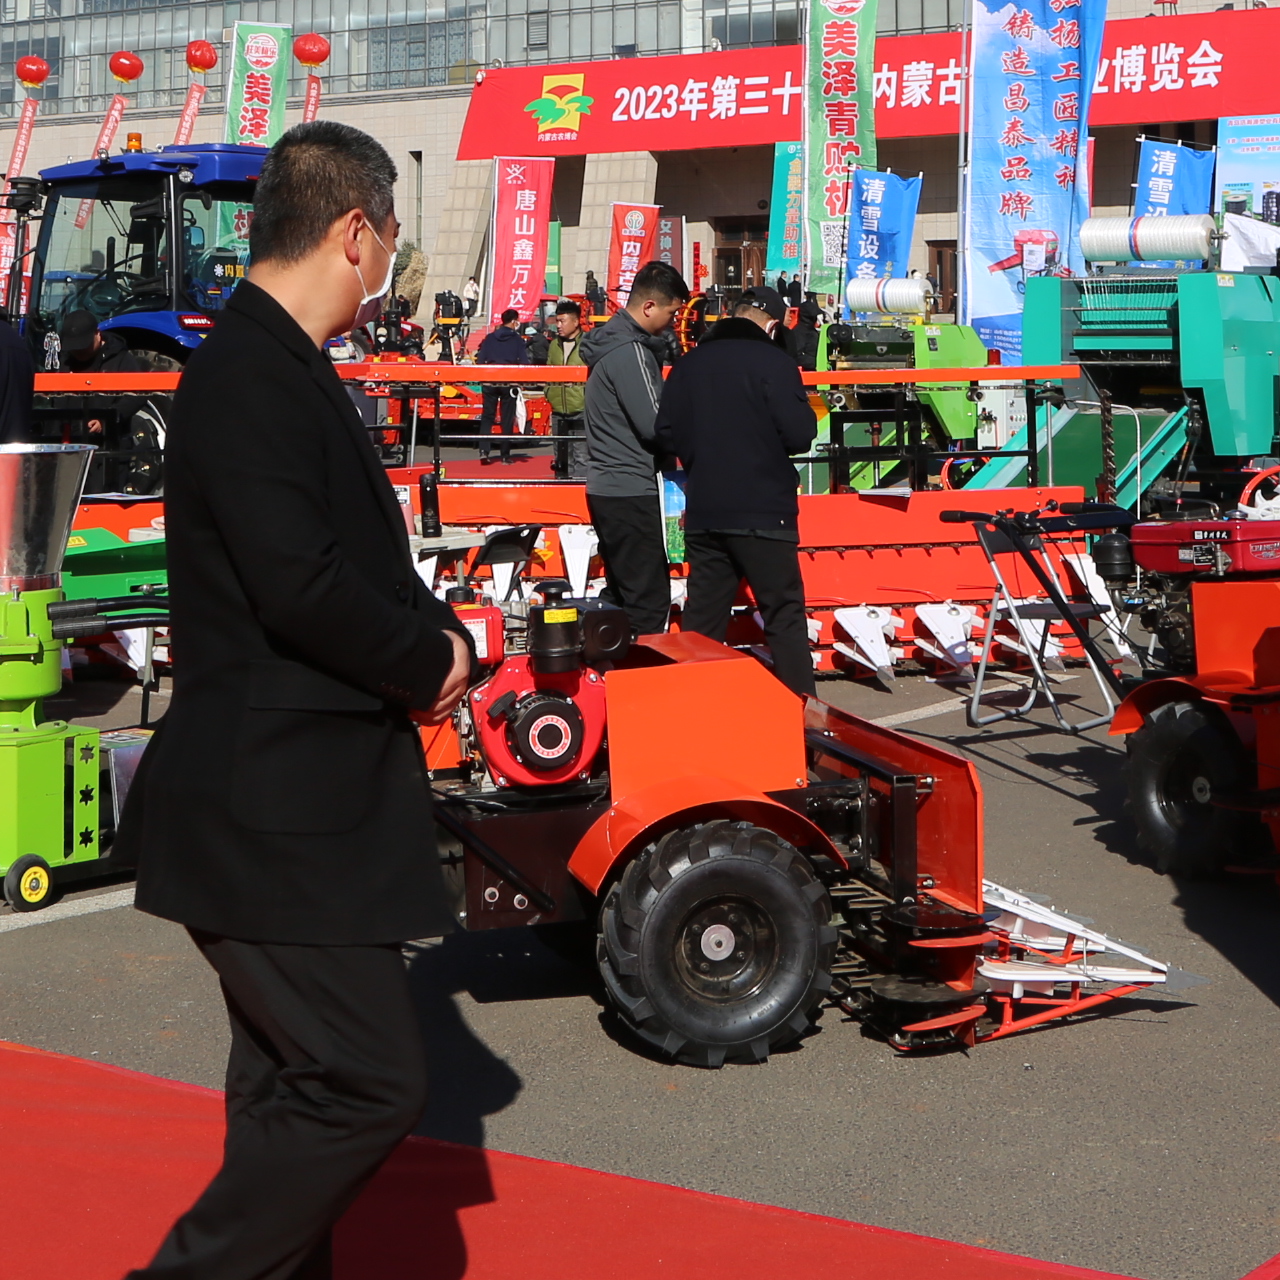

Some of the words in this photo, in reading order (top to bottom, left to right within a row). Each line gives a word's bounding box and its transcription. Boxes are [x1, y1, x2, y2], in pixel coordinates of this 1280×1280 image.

[537, 131, 578, 142] 内蒙古农博会
[998, 8, 1036, 221] 铸造昌泰品牌
[507, 189, 537, 308] 唐山鑫万达
[782, 157, 802, 259] 金融力量助推
